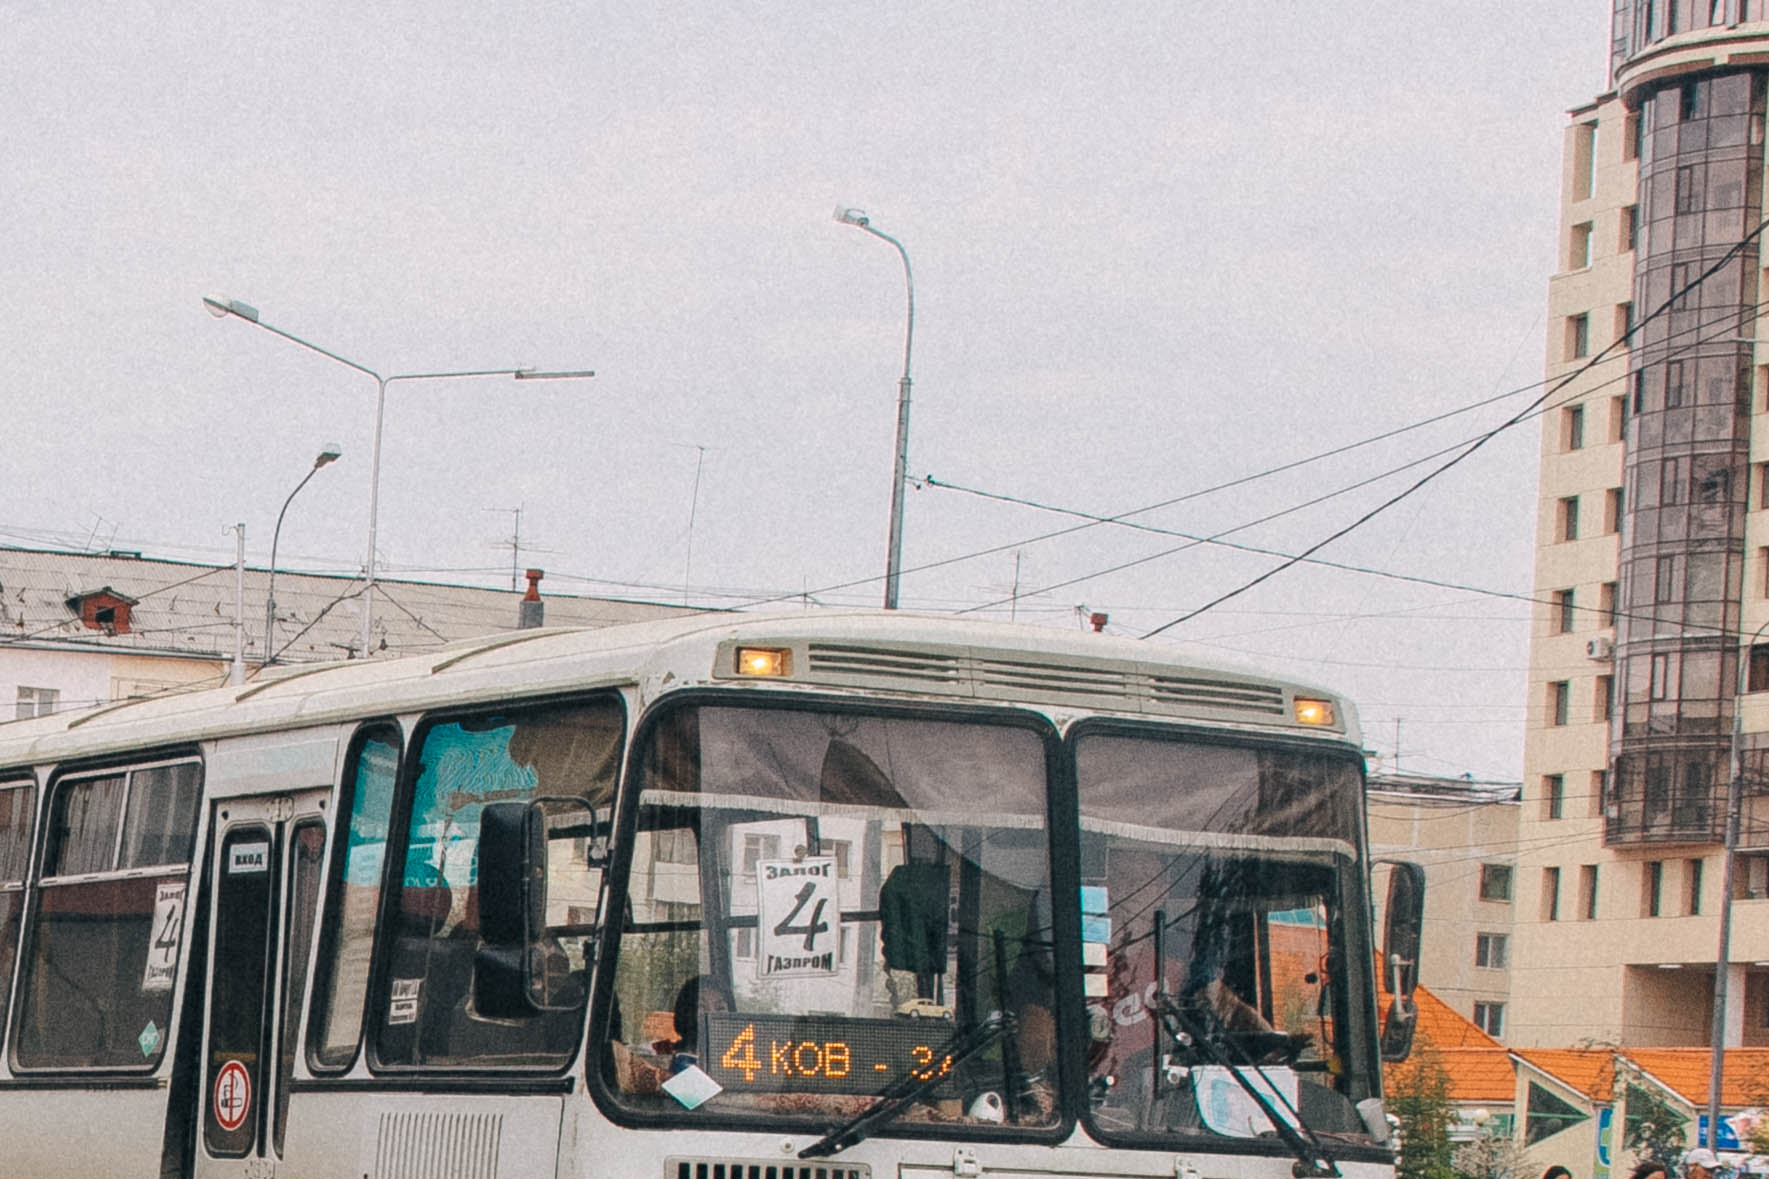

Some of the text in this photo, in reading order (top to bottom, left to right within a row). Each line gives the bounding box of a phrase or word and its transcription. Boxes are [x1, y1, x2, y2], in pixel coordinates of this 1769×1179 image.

[765, 863, 831, 880] ЗАЛОГ
[154, 904, 179, 963] 4
[773, 882, 829, 951] 4
[767, 951, 833, 975] ГАЗПРОМ
[722, 1023, 763, 1083] 4
[771, 1040, 850, 1078] КОВ
